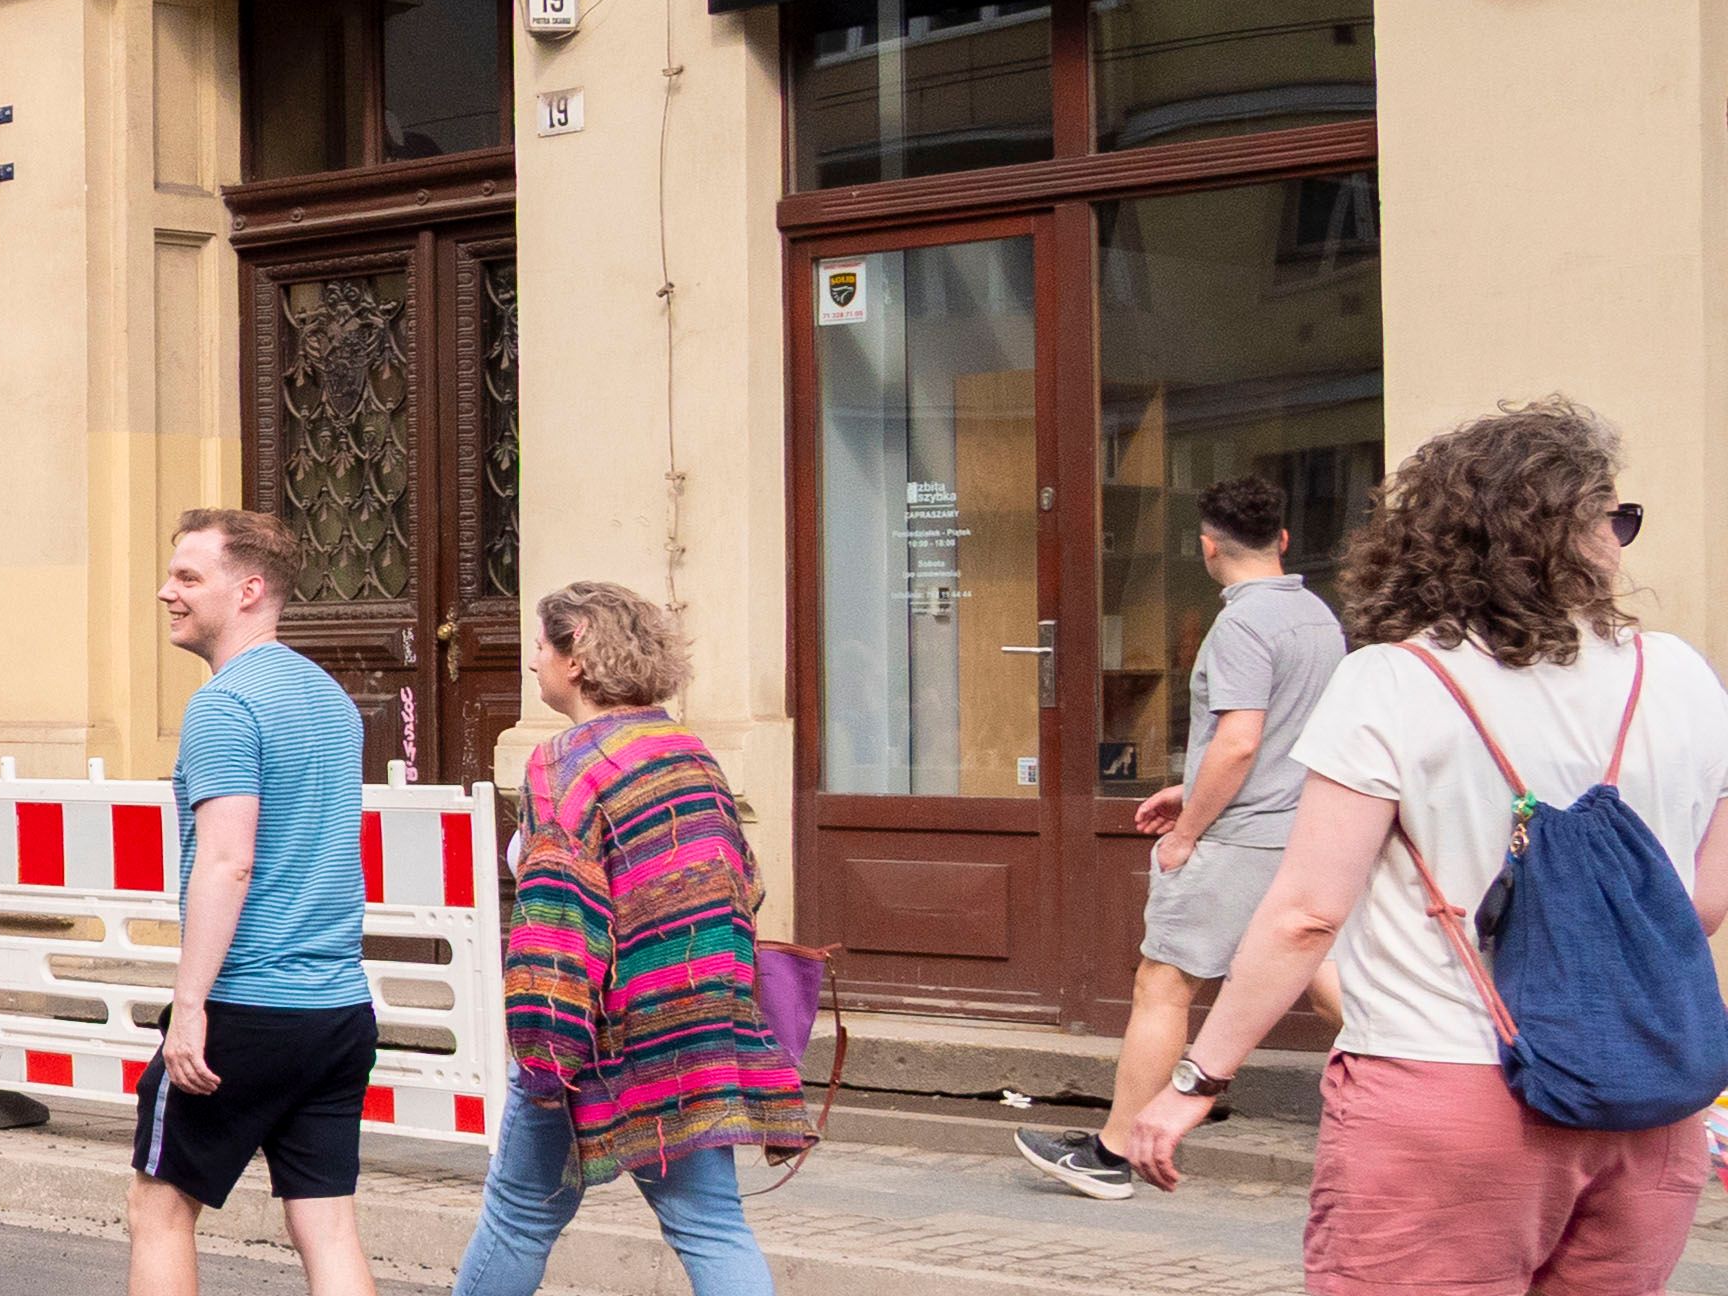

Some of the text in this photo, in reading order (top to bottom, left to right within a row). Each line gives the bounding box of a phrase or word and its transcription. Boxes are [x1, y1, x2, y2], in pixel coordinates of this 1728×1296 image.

[547, 96, 569, 129] 19
[917, 481, 945, 492] zbita
[917, 492, 957, 504] szybka
[904, 510, 960, 520] ZAPRASZAMY
